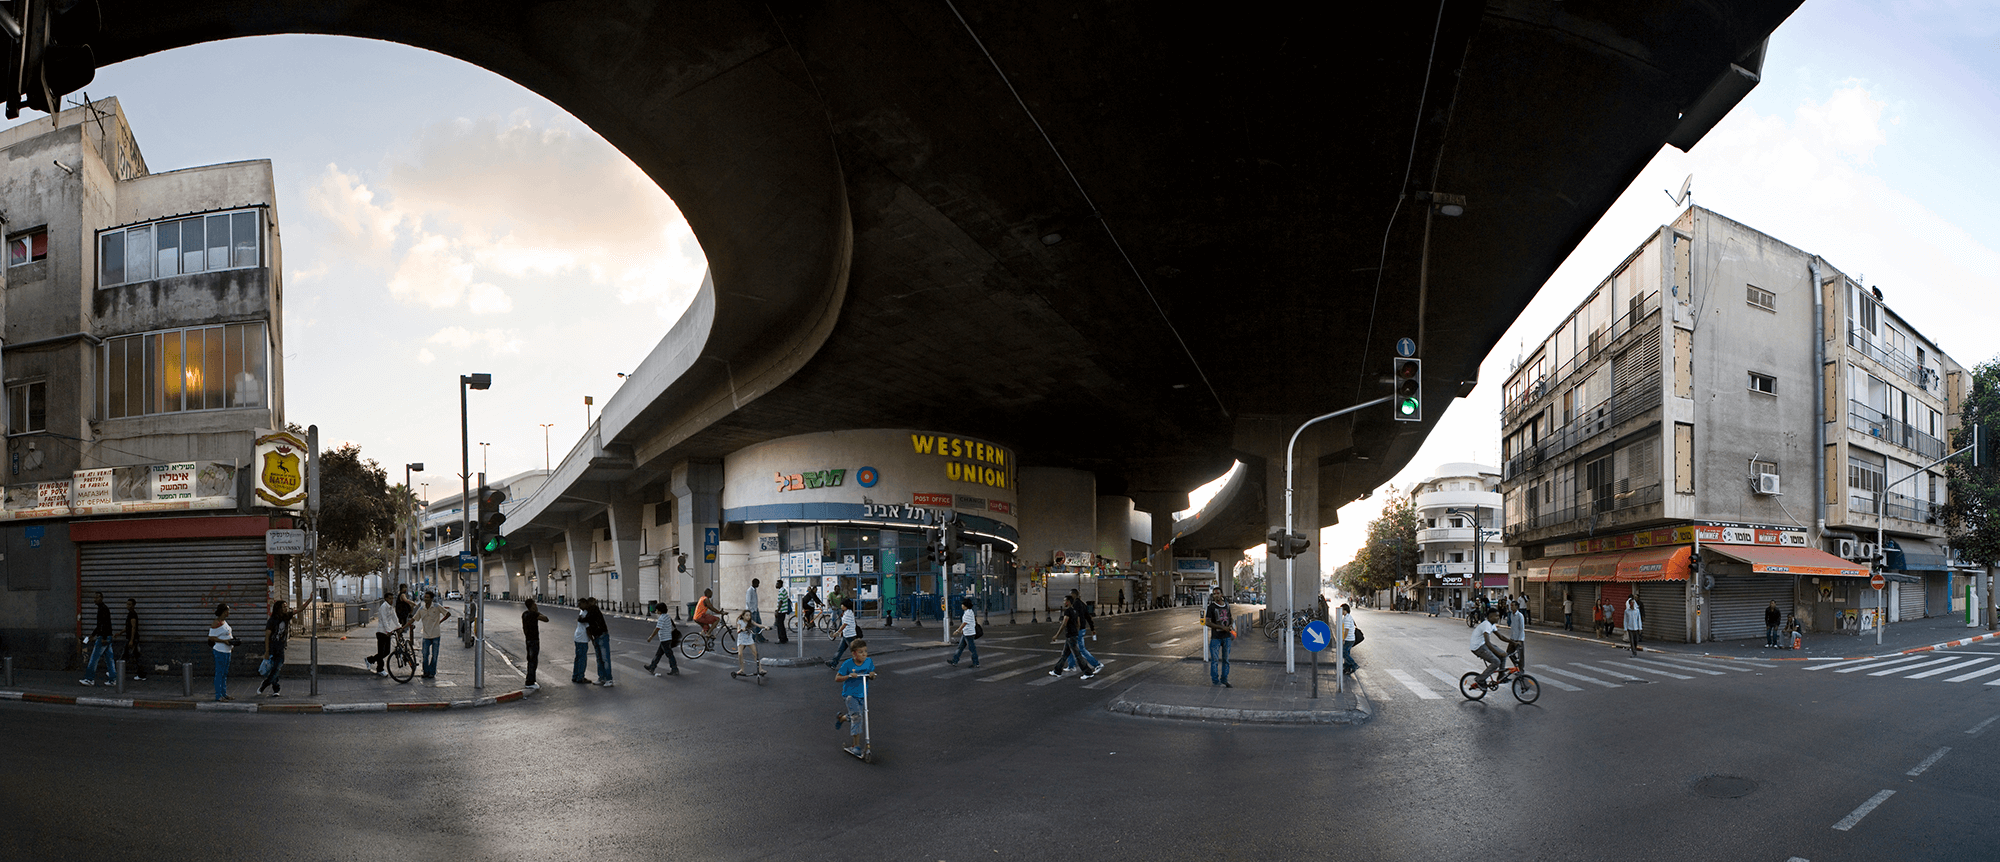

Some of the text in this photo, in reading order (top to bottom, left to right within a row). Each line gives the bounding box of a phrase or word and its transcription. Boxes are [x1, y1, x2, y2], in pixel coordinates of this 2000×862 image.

[911, 434, 1004, 466] WESTERN
[946, 461, 1005, 488] UNION
[39, 481, 70, 490] KINGDOM
[269, 476, 296, 485] NATALI
[78, 490, 109, 498] МАГАЗИН
[75, 499, 86, 507] ОТ
[863, 504, 900, 518] אביב
[904, 502, 926, 520] תל
[1734, 532, 1752, 542] טוטו
[1789, 535, 1805, 545] טוטו
[761, 542, 767, 551] 6
